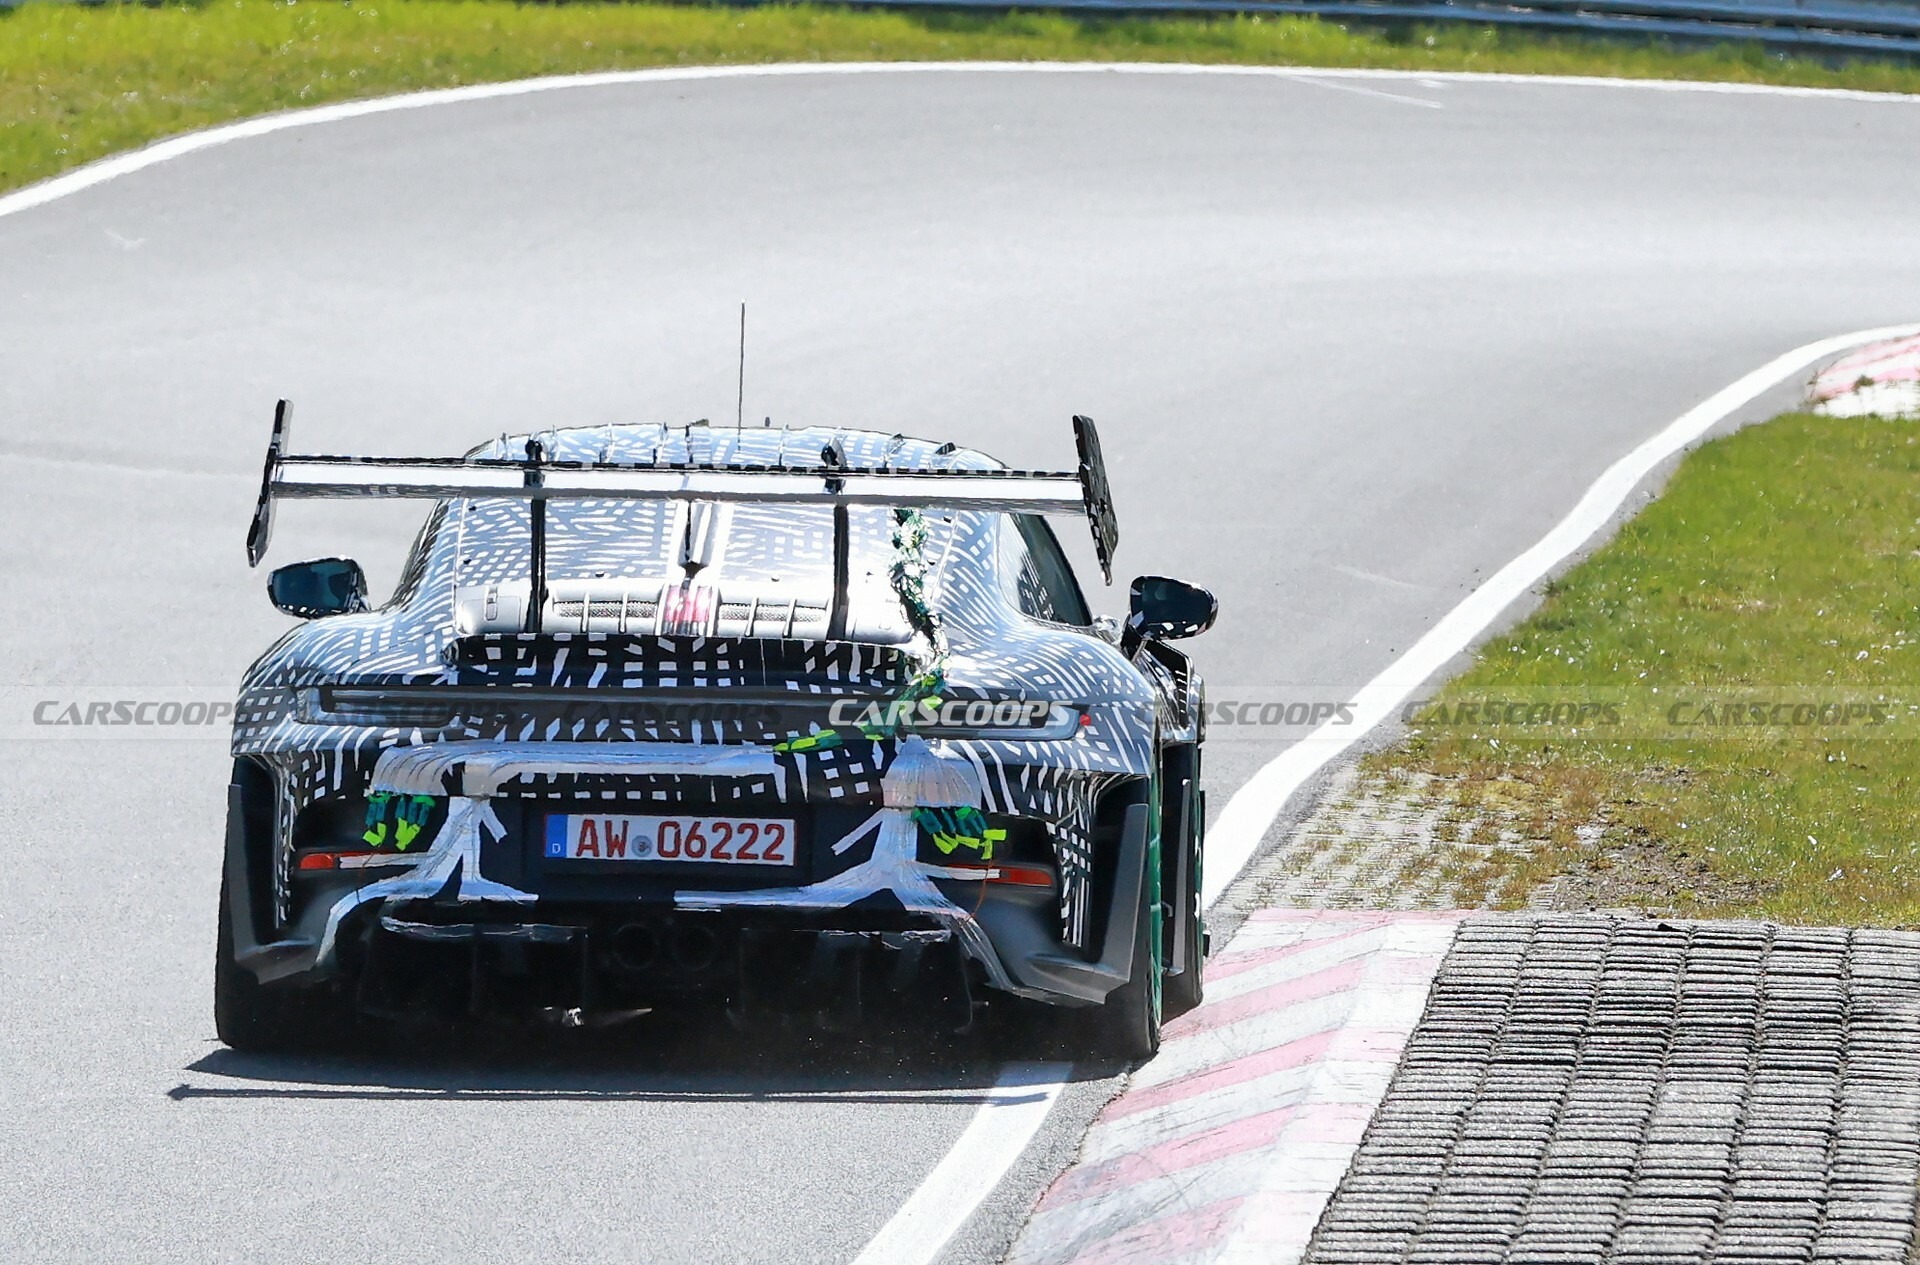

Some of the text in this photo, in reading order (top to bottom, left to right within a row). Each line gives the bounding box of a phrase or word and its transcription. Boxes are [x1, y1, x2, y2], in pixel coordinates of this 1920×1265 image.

[552, 843, 561, 854] D
[576, 819, 785, 861] AW 06222
